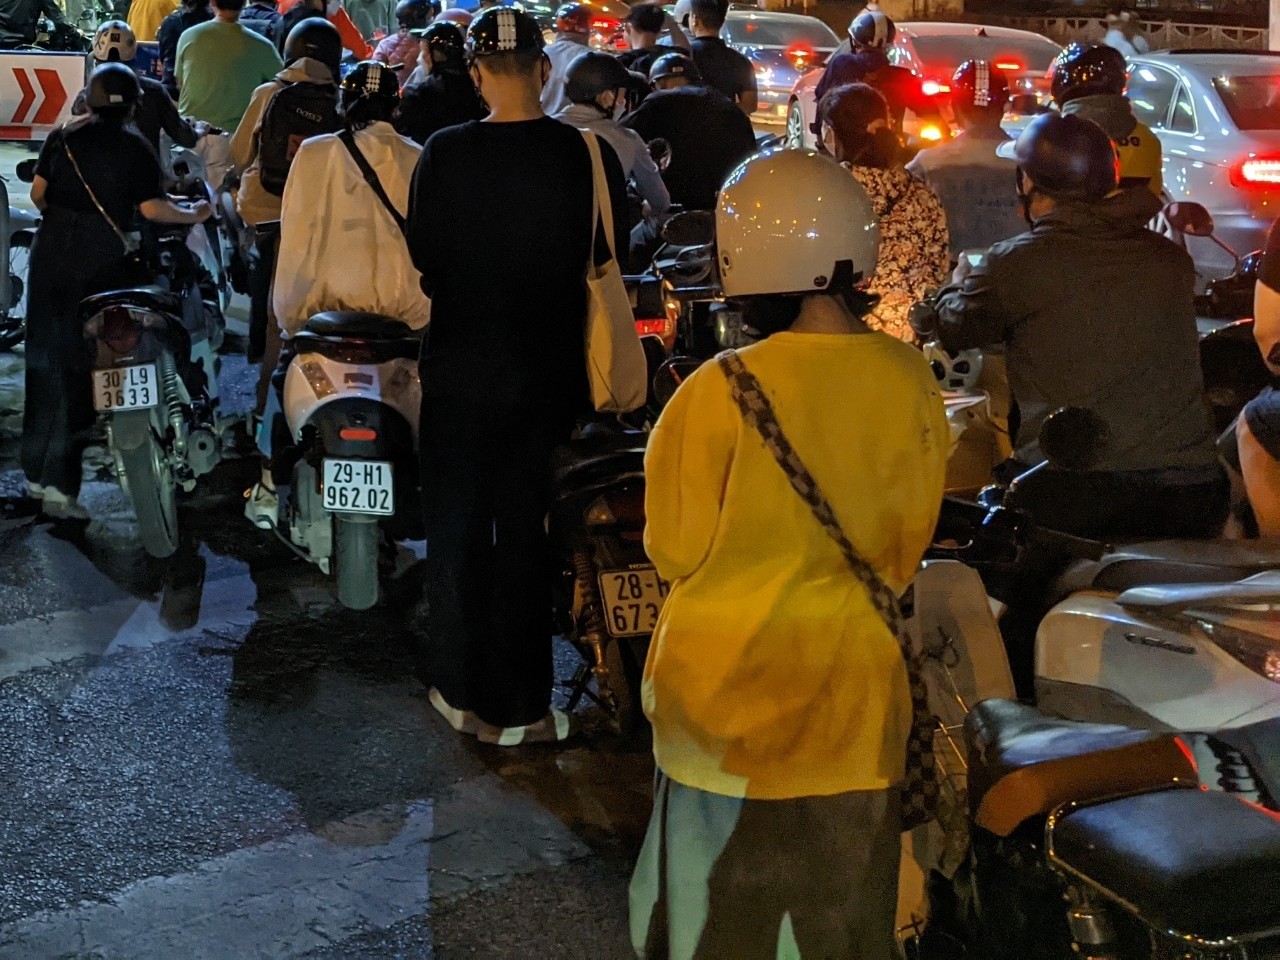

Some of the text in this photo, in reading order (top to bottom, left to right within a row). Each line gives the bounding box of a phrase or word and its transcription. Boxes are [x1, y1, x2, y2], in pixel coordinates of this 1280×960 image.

[102, 367, 149, 389] 30-L9
[102, 387, 150, 408] 3633
[333, 462, 382, 486] 29-H1
[327, 486, 390, 510] 962.02
